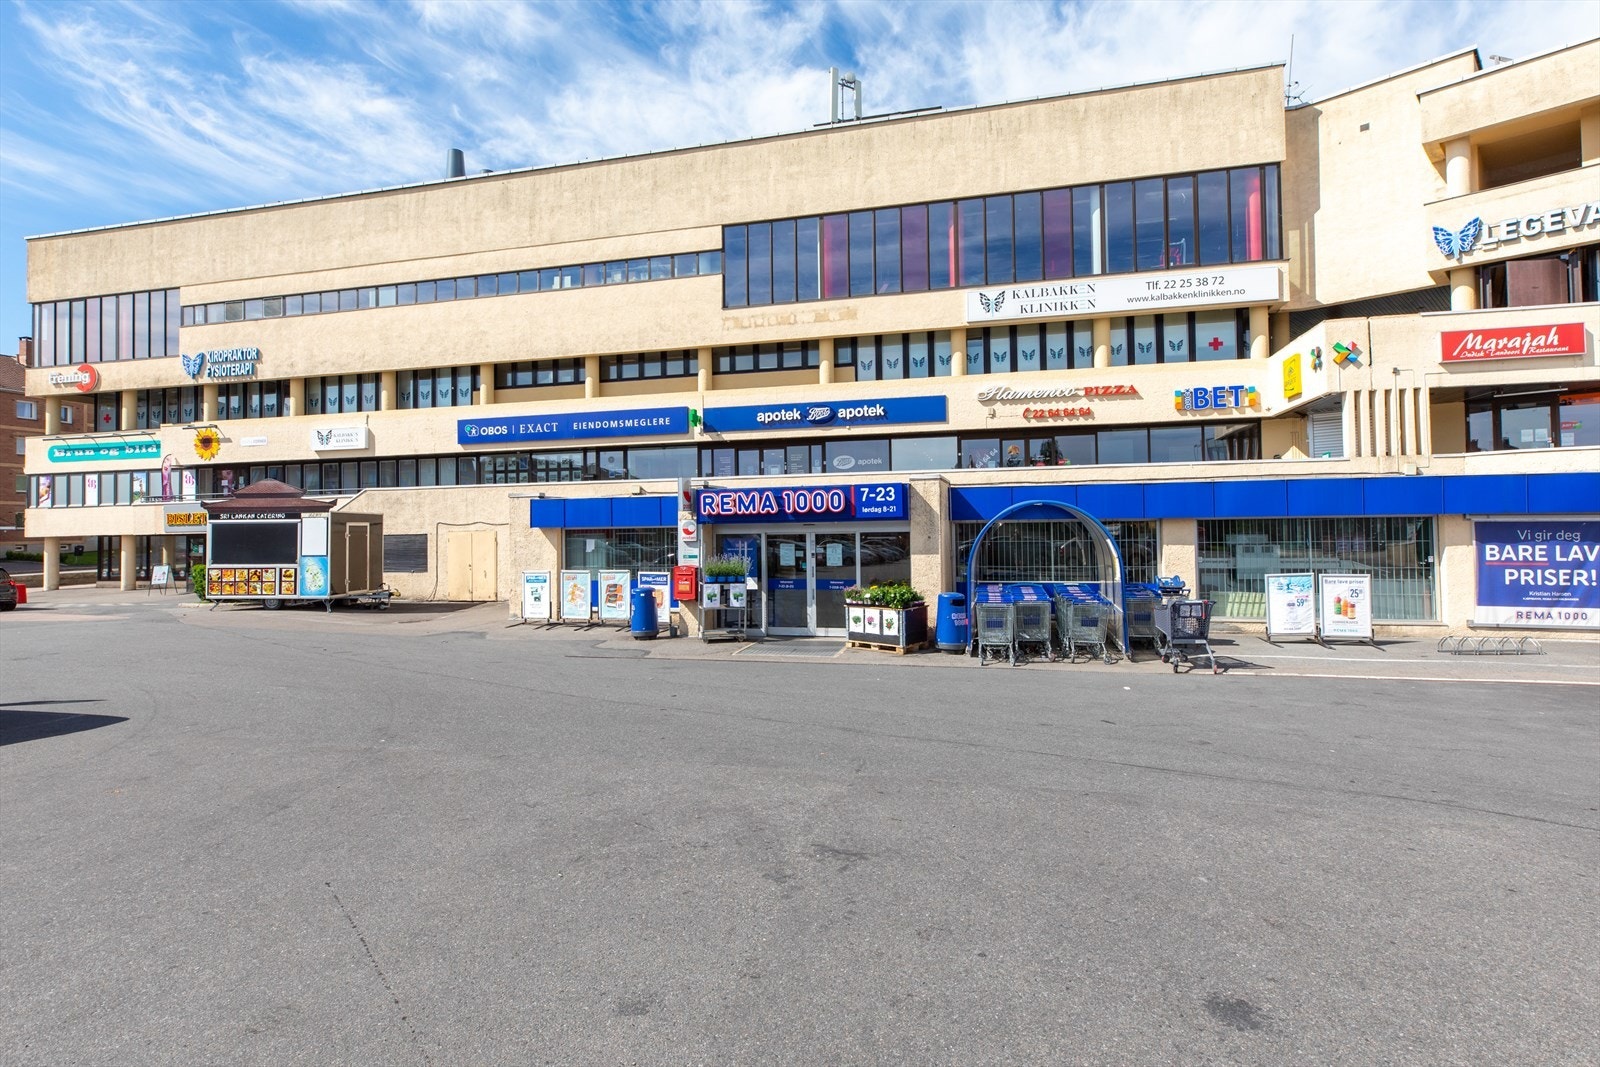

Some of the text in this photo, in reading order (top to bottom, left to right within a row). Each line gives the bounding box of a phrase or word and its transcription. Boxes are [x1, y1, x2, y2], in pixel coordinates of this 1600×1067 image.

[1146, 275, 1225, 291] Tlf. 22 25 38 72
[1012, 283, 1096, 300] KALBAKKEN
[1127, 287, 1246, 304] www.kalbakkenklinikken.no
[1020, 298, 1096, 315] KLINIKKEN
[1452, 326, 1559, 356] Marajah
[206, 347, 258, 363] KIROPRAKTOR
[1459, 350, 1485, 358] Indisk
[206, 362, 255, 377] FYSIOTERAPI
[977, 384, 1137, 401] Flamenco PIZZA
[1193, 385, 1244, 410] BET
[756, 408, 801, 424] apotek
[837, 403, 884, 419] apotek
[1033, 407, 1091, 418] 22 64 64 64
[480, 417, 671, 436] OBOS EXACT EIENDOMSMEGLERE
[53, 445, 157, 457] Brun og blid
[857, 457, 882, 466] apotek
[700, 489, 846, 516] REMA 1000
[860, 487, 895, 502] 7-23
[883, 505, 896, 513] 8-21
[1517, 529, 1581, 543] Vi gir deg
[1485, 544, 1548, 561] BARE
[1504, 568, 1598, 586] PRISER!
[1516, 611, 1588, 621] REMA 1000
